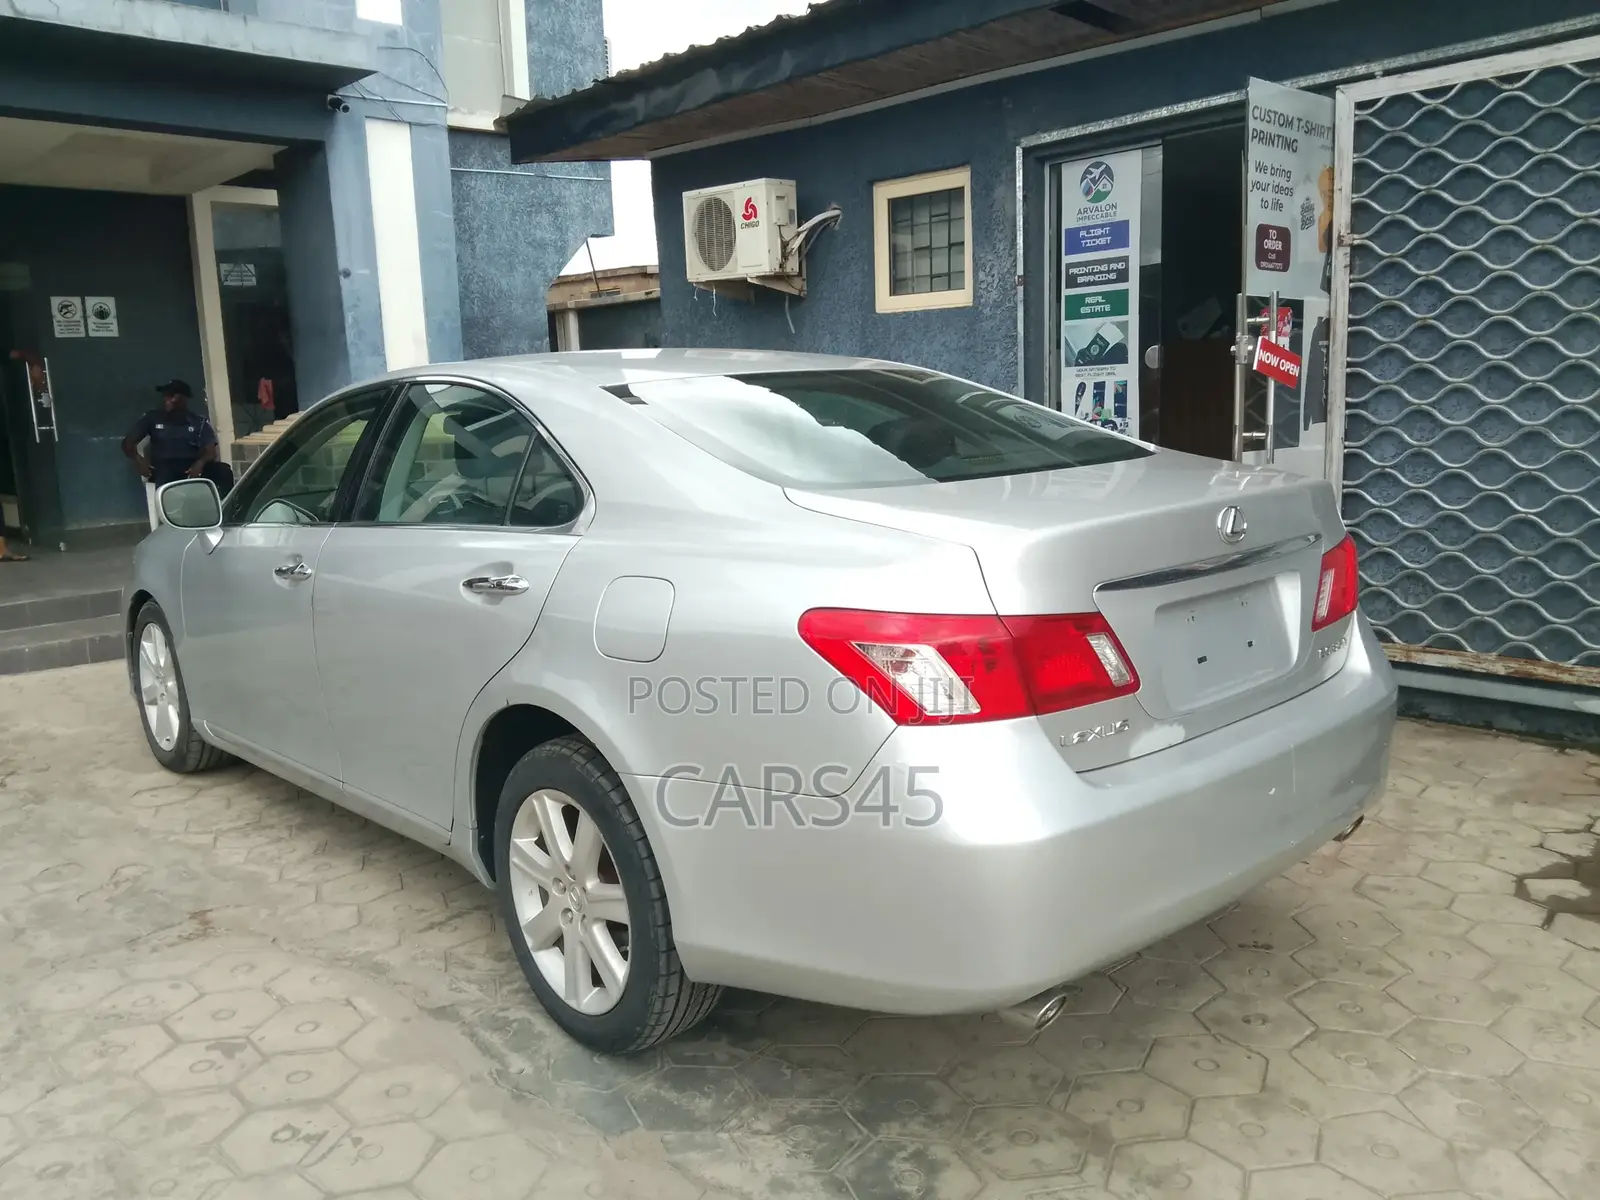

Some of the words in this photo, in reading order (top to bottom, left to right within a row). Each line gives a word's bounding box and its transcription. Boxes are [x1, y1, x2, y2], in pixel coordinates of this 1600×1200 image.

[1252, 105, 1294, 130] CUSTOM
[1297, 117, 1332, 141] T-SHIRT
[1251, 128, 1299, 153] PRINTING
[1254, 159, 1269, 175] We
[1270, 163, 1293, 183] bring
[1250, 179, 1271, 193] your
[1271, 180, 1294, 198] ideas
[1076, 202, 1117, 217] ARVALON
[1260, 197, 1270, 210] to
[1271, 197, 1284, 213] life
[1076, 211, 1117, 223] IMPECCABLE
[740, 220, 760, 230] CHIGO
[1080, 227, 1110, 238] FLIGHT
[1268, 229, 1278, 240] TO
[1081, 237, 1111, 247] TICKET
[1263, 239, 1283, 251] ORDER
[1068, 264, 1108, 275] PRINTING
[1109, 262, 1126, 270] AND
[1076, 272, 1117, 284] BRANDING
[1085, 296, 1105, 304] REAL
[1080, 305, 1110, 313] ESTATE
[1258, 349, 1279, 368] NOW
[1279, 358, 1300, 377] OPEN
[1060, 719, 1130, 747] LEXUS
